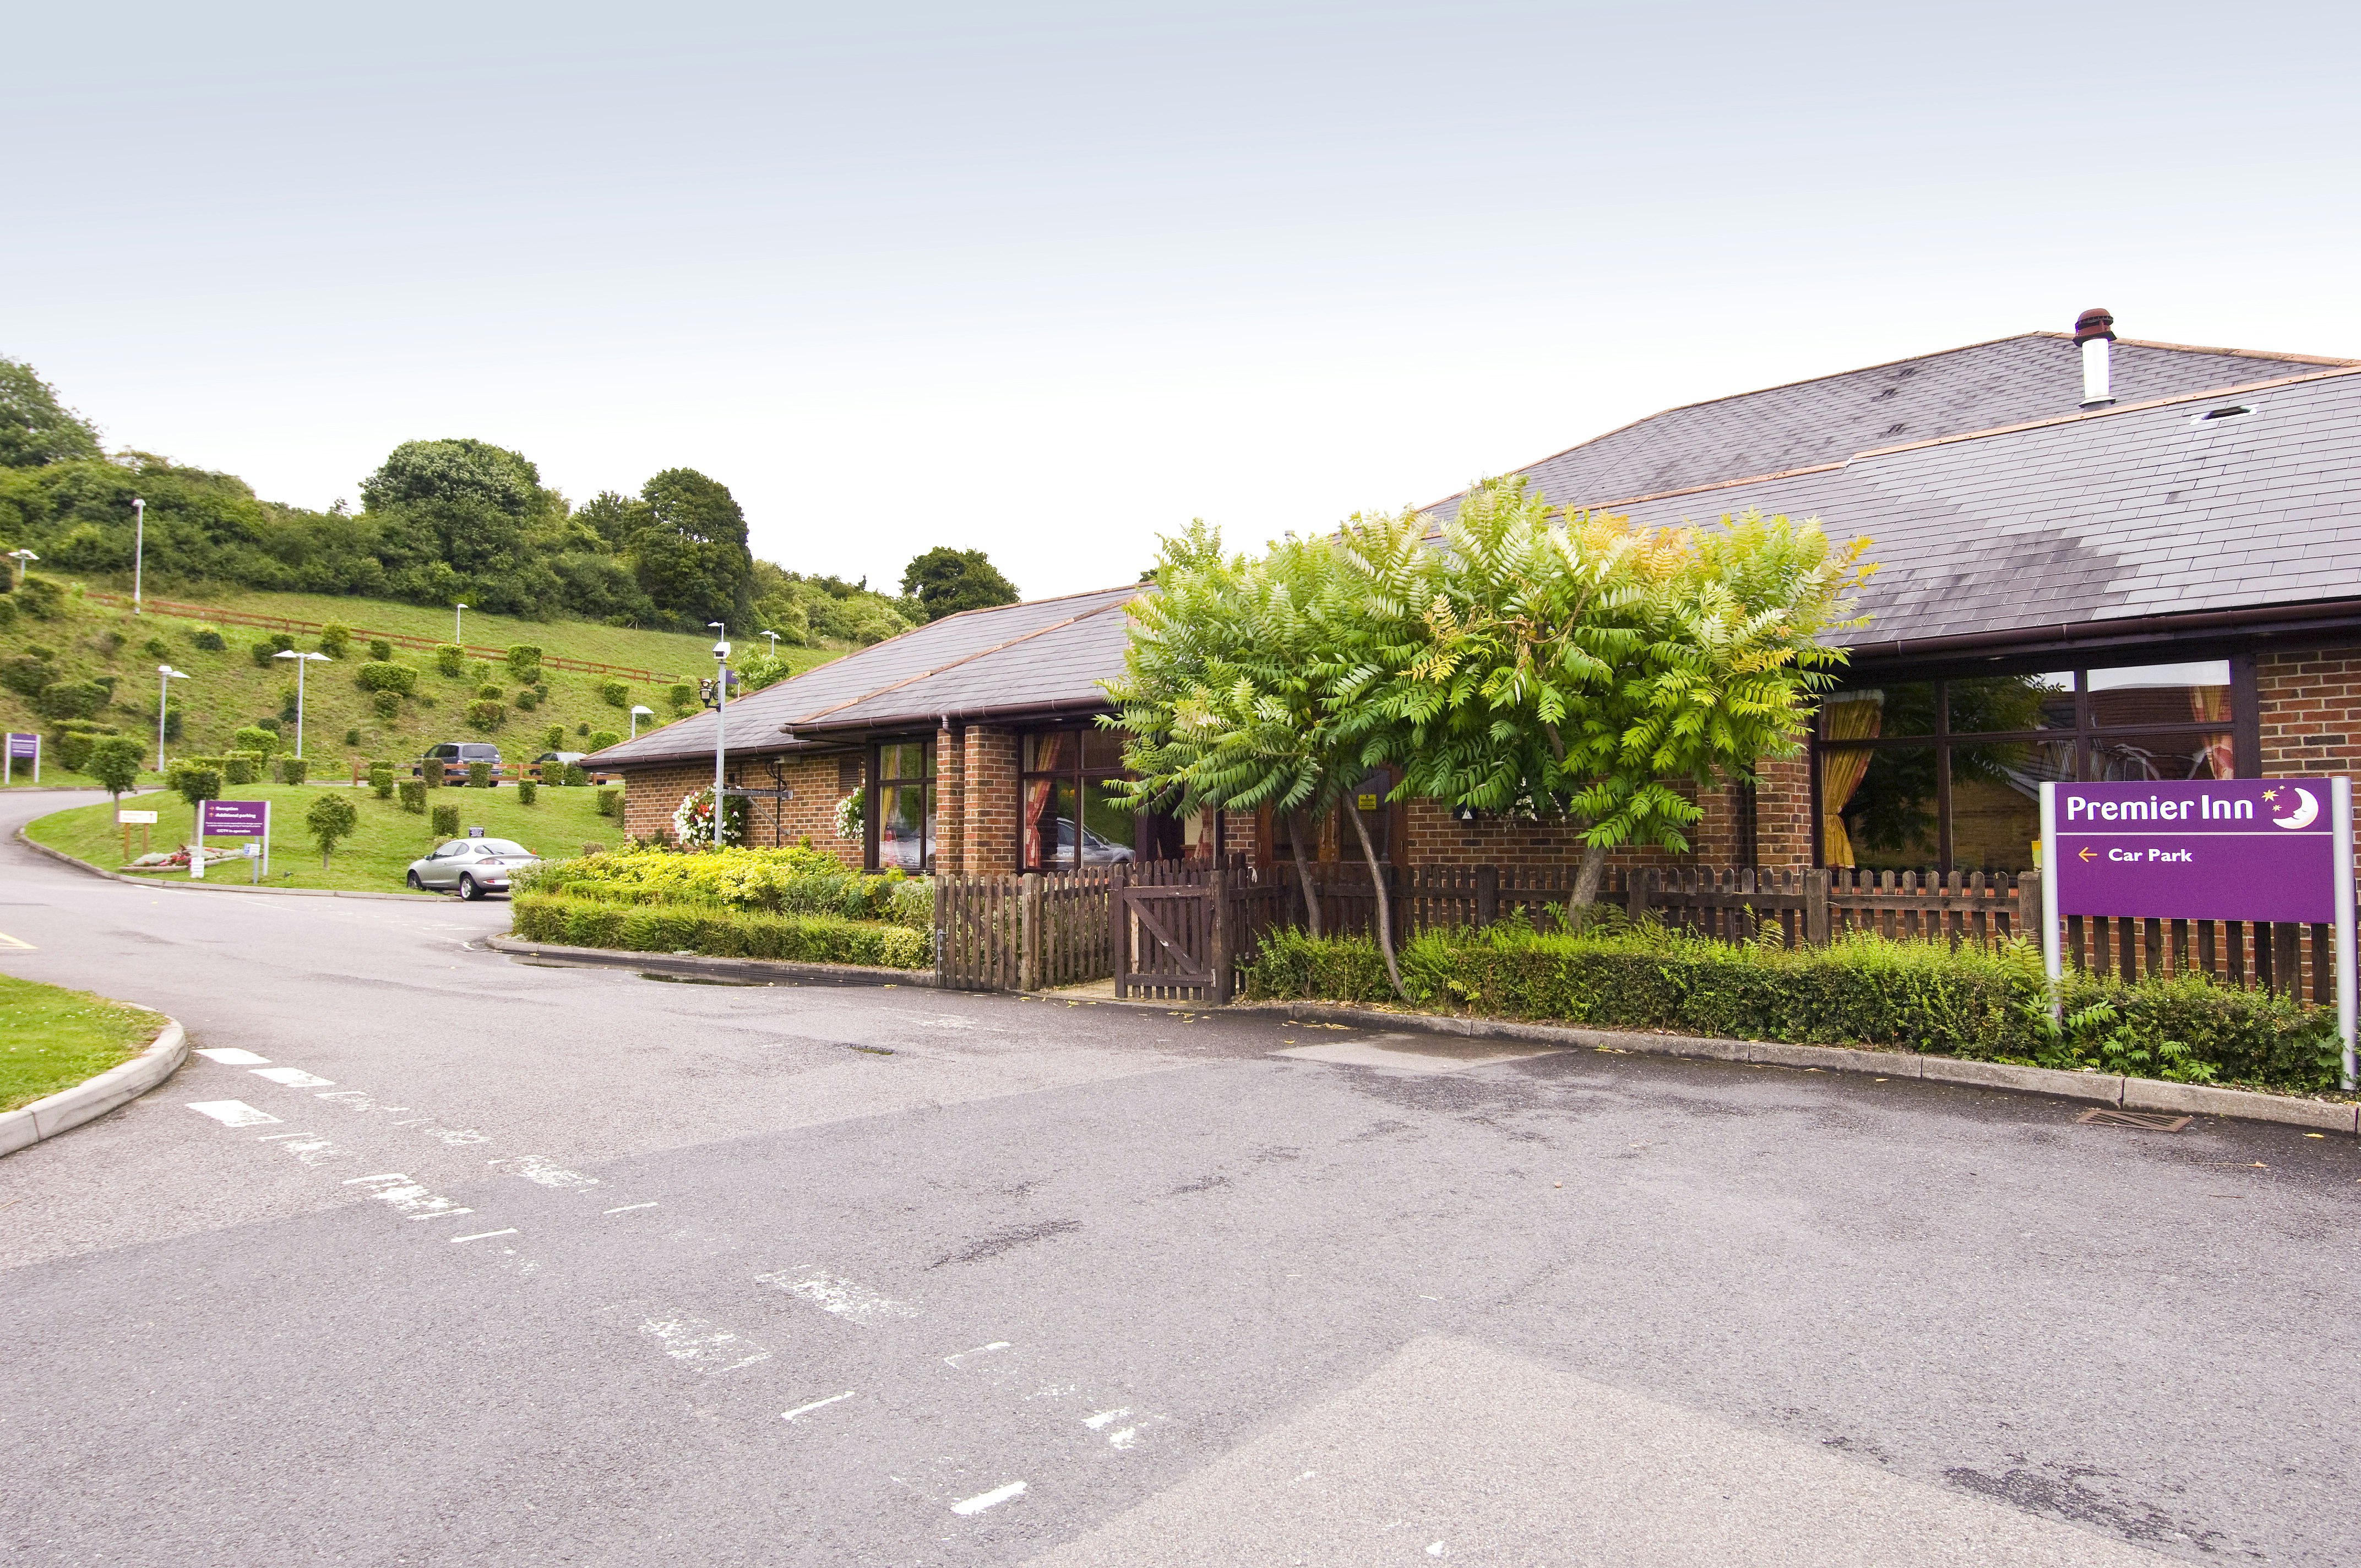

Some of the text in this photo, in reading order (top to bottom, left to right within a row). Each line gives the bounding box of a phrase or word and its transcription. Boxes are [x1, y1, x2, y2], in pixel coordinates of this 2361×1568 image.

[2067, 794, 2253, 820] Premier Inn
[2108, 848, 2193, 862] Car Park
